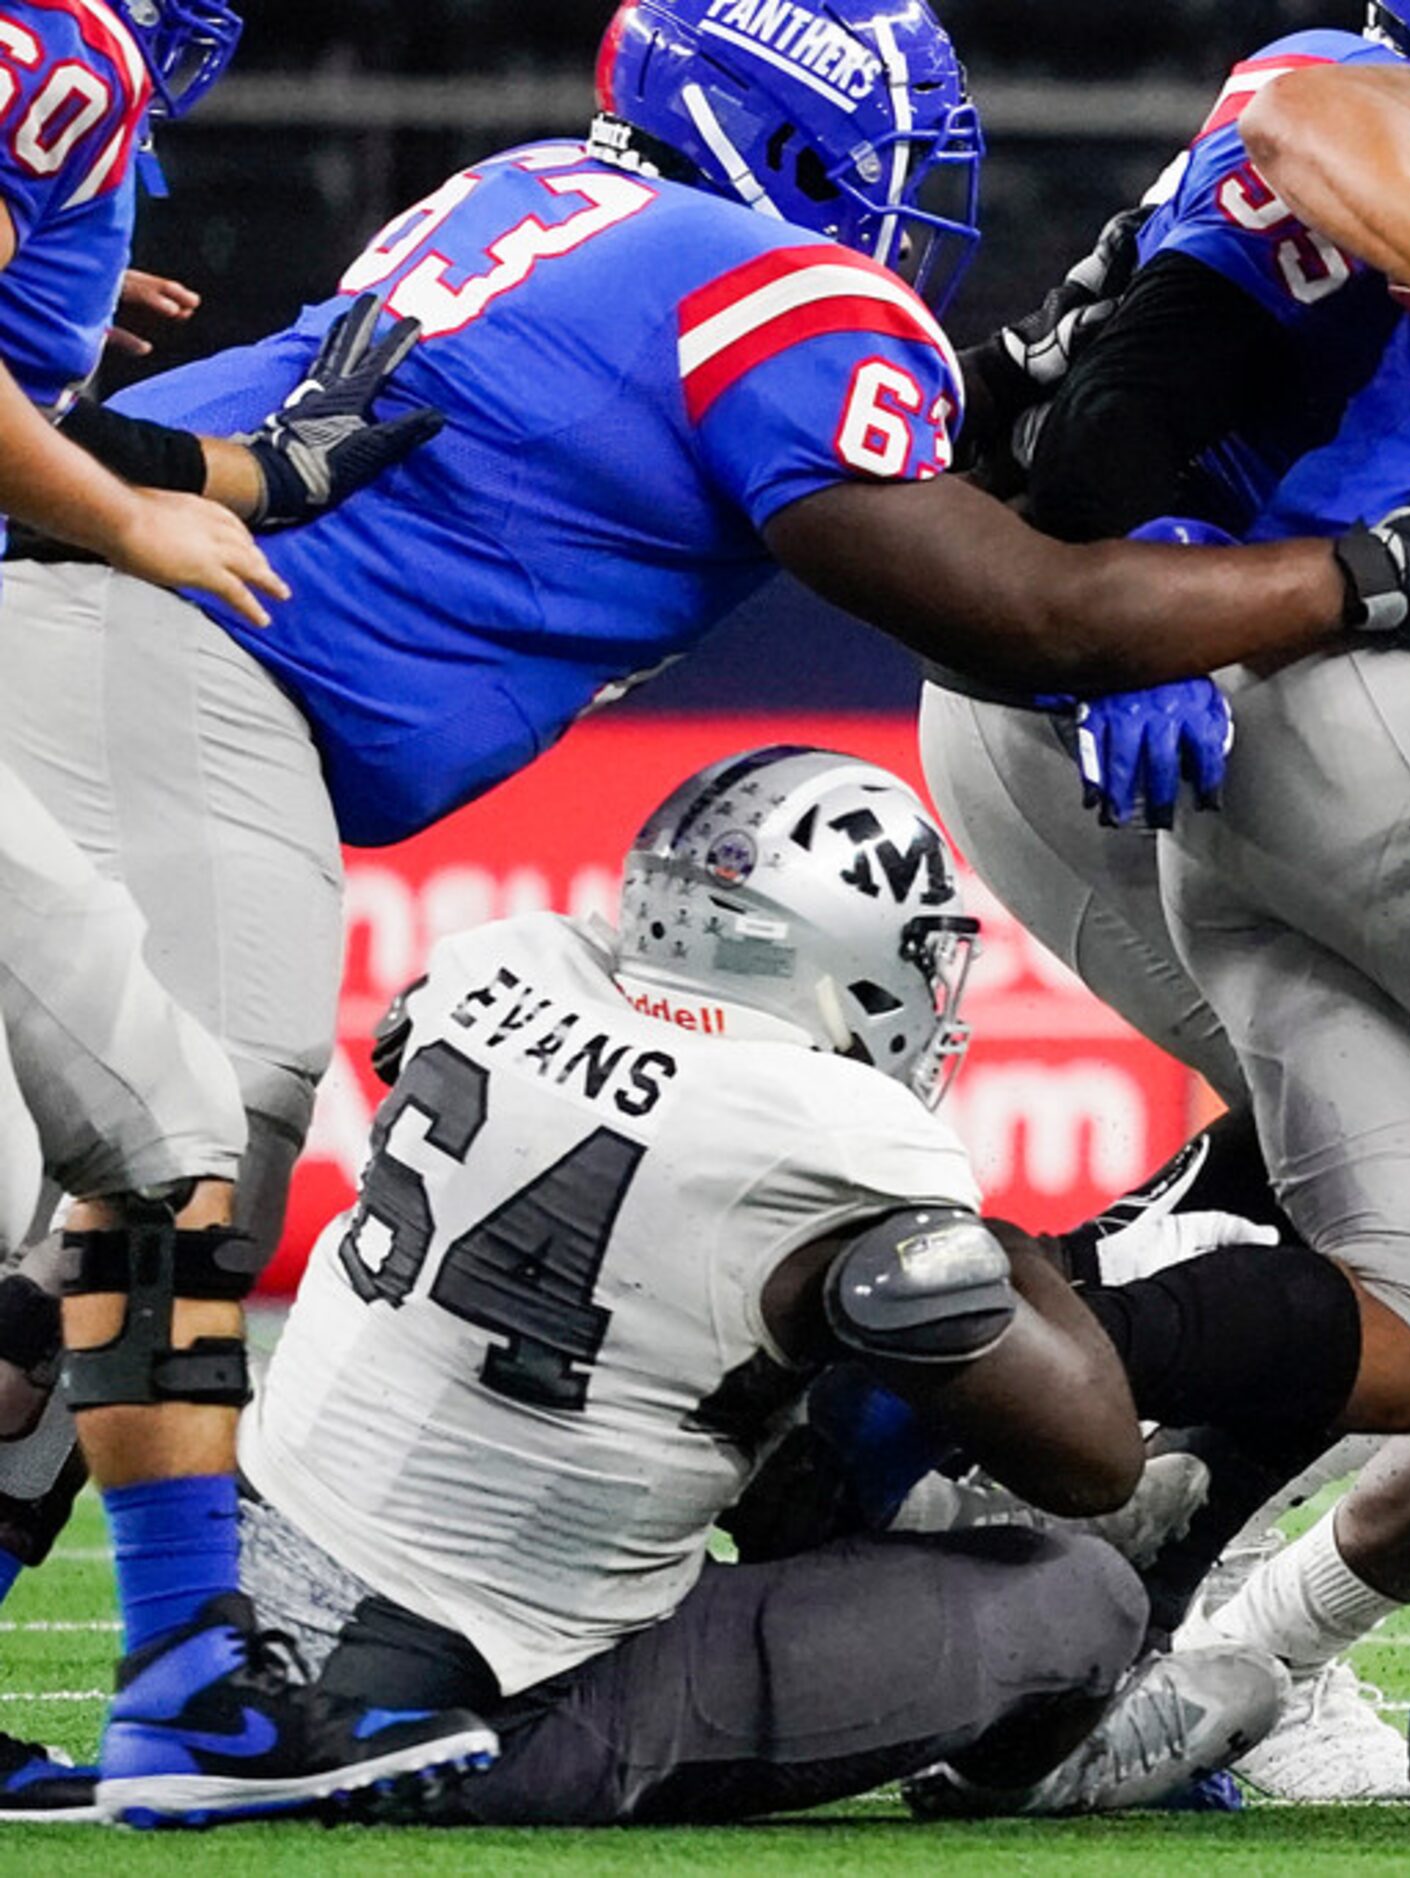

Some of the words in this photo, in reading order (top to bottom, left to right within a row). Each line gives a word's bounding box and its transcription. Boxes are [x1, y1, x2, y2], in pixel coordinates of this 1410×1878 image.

[337, 143, 660, 343] 63
[450, 966, 678, 1117] EVANS
[626, 993, 725, 1034] ddell
[337, 1037, 650, 1412] 64
